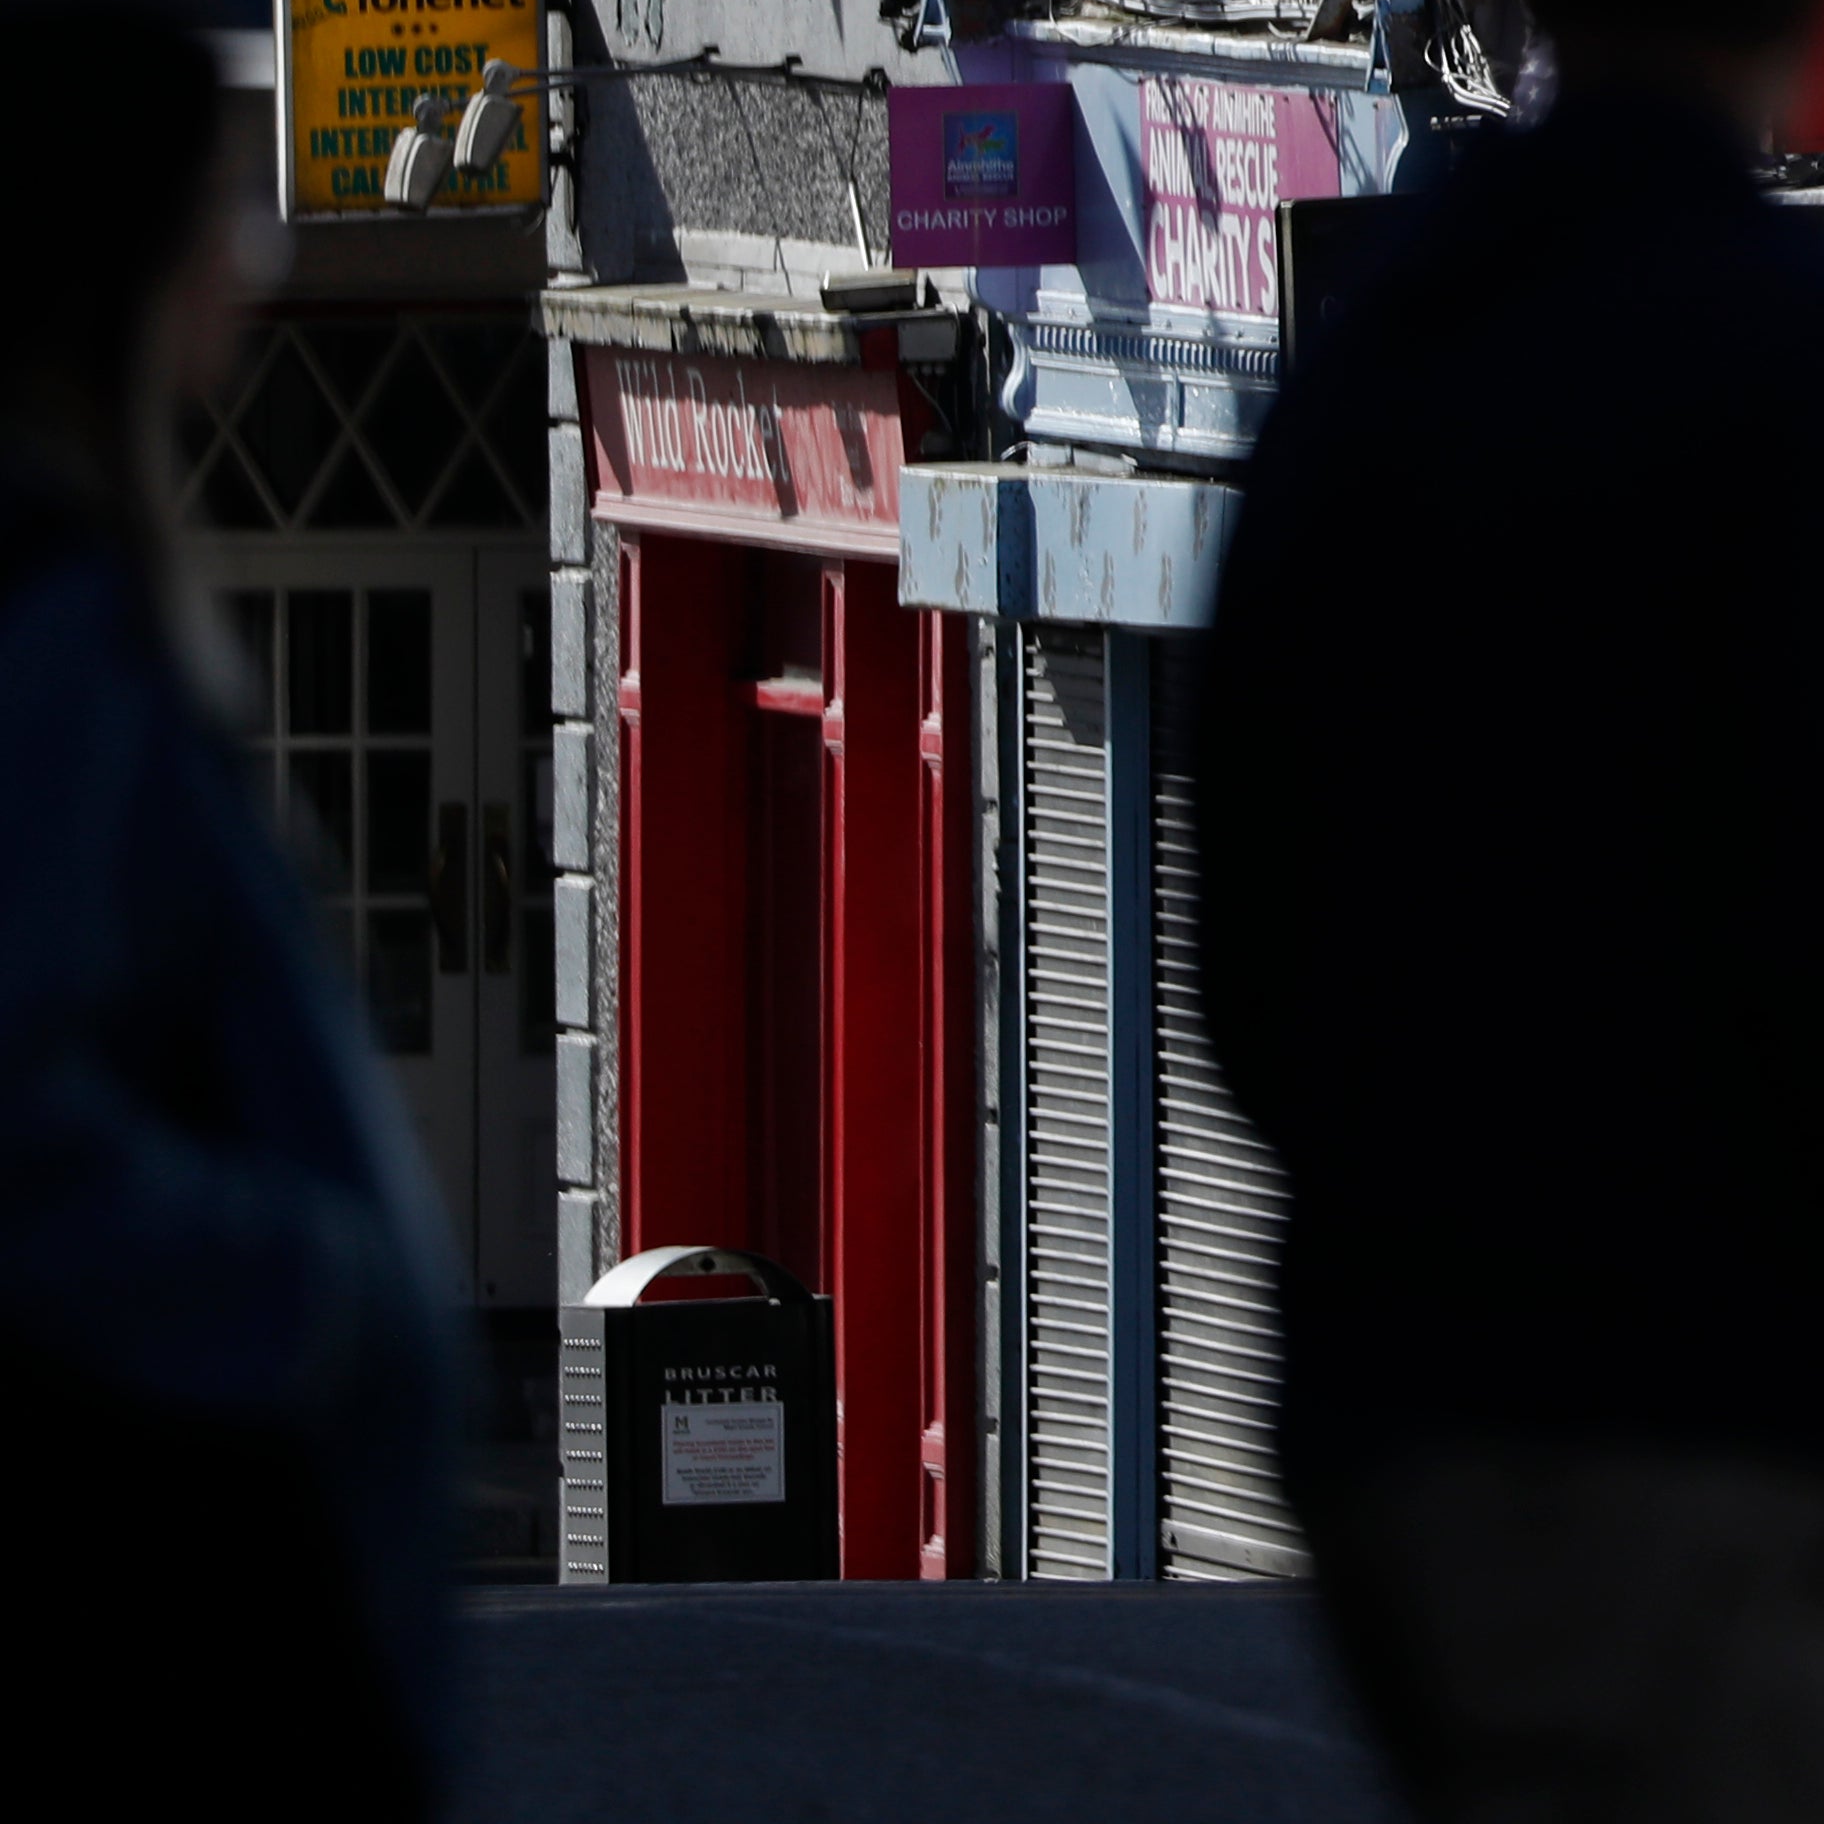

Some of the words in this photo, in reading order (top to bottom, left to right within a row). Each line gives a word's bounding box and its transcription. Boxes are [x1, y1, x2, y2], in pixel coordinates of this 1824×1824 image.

[345, 46, 407, 78] LOW
[414, 42, 490, 76] COST
[1193, 83, 1211, 128] OF
[1148, 126, 1216, 202] ANIMAL
[1215, 138, 1279, 212] RESCUE
[896, 207, 998, 232] CHARITY
[1003, 205, 1068, 229] SHOP
[1150, 200, 1253, 313] CHARITY
[615, 359, 686, 474] Wild
[686, 366, 789, 486] Rocket
[663, 1363, 778, 1382] BRUSCAR
[664, 1385, 778, 1404] LITTER
